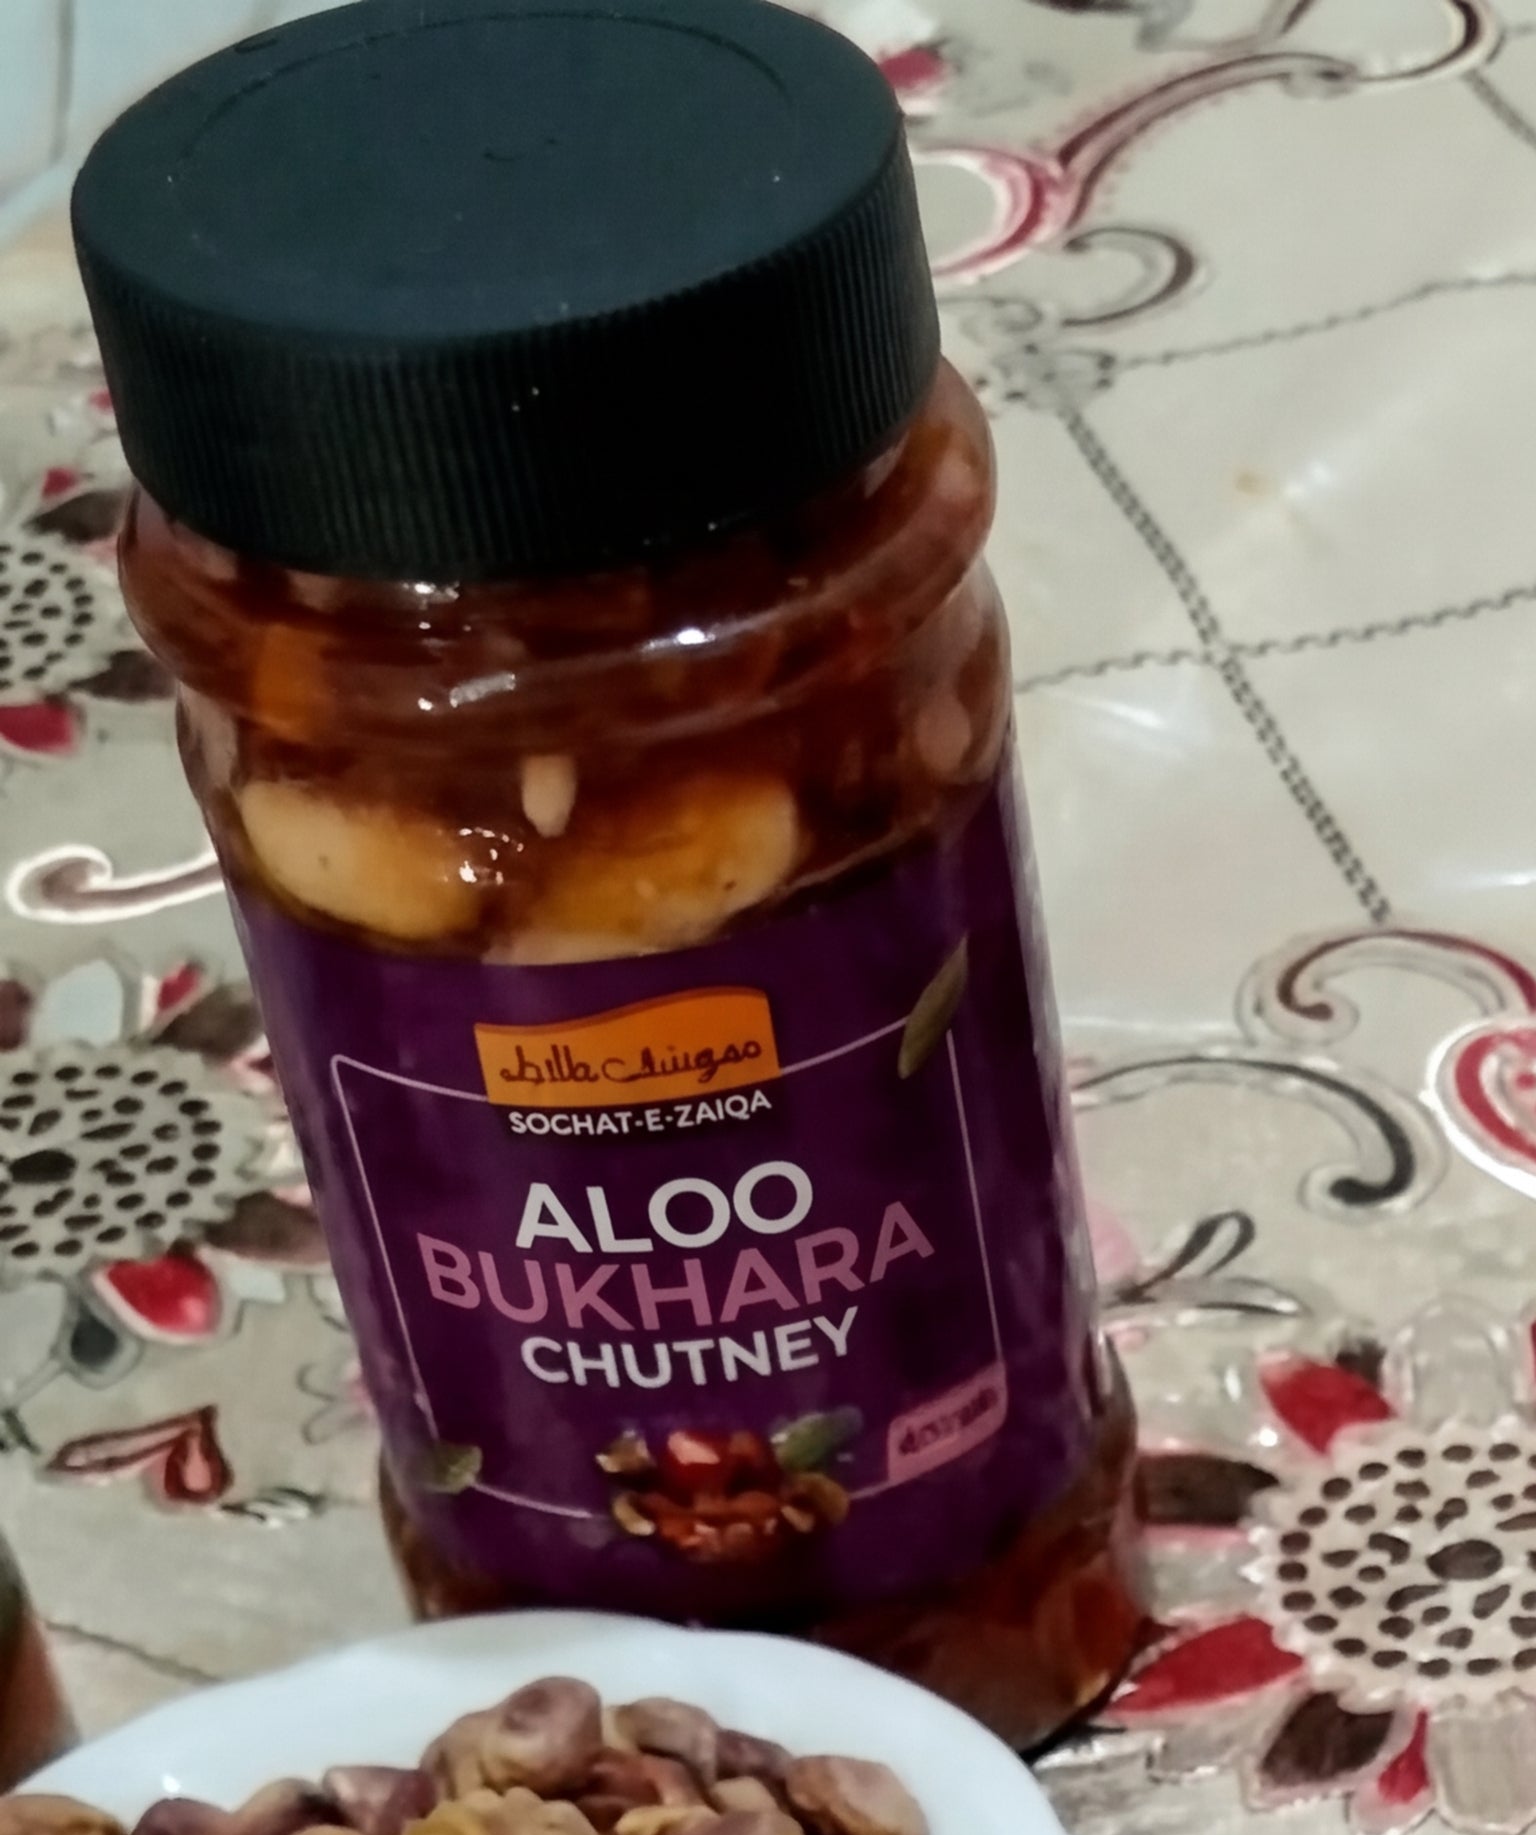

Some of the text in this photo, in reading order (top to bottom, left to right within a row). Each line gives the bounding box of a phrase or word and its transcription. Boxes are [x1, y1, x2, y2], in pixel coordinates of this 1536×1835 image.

[515, 1161, 814, 1253] ALOO
[417, 1201, 934, 1331] BUKHARA
[521, 1306, 858, 1389] CHUTNEY
